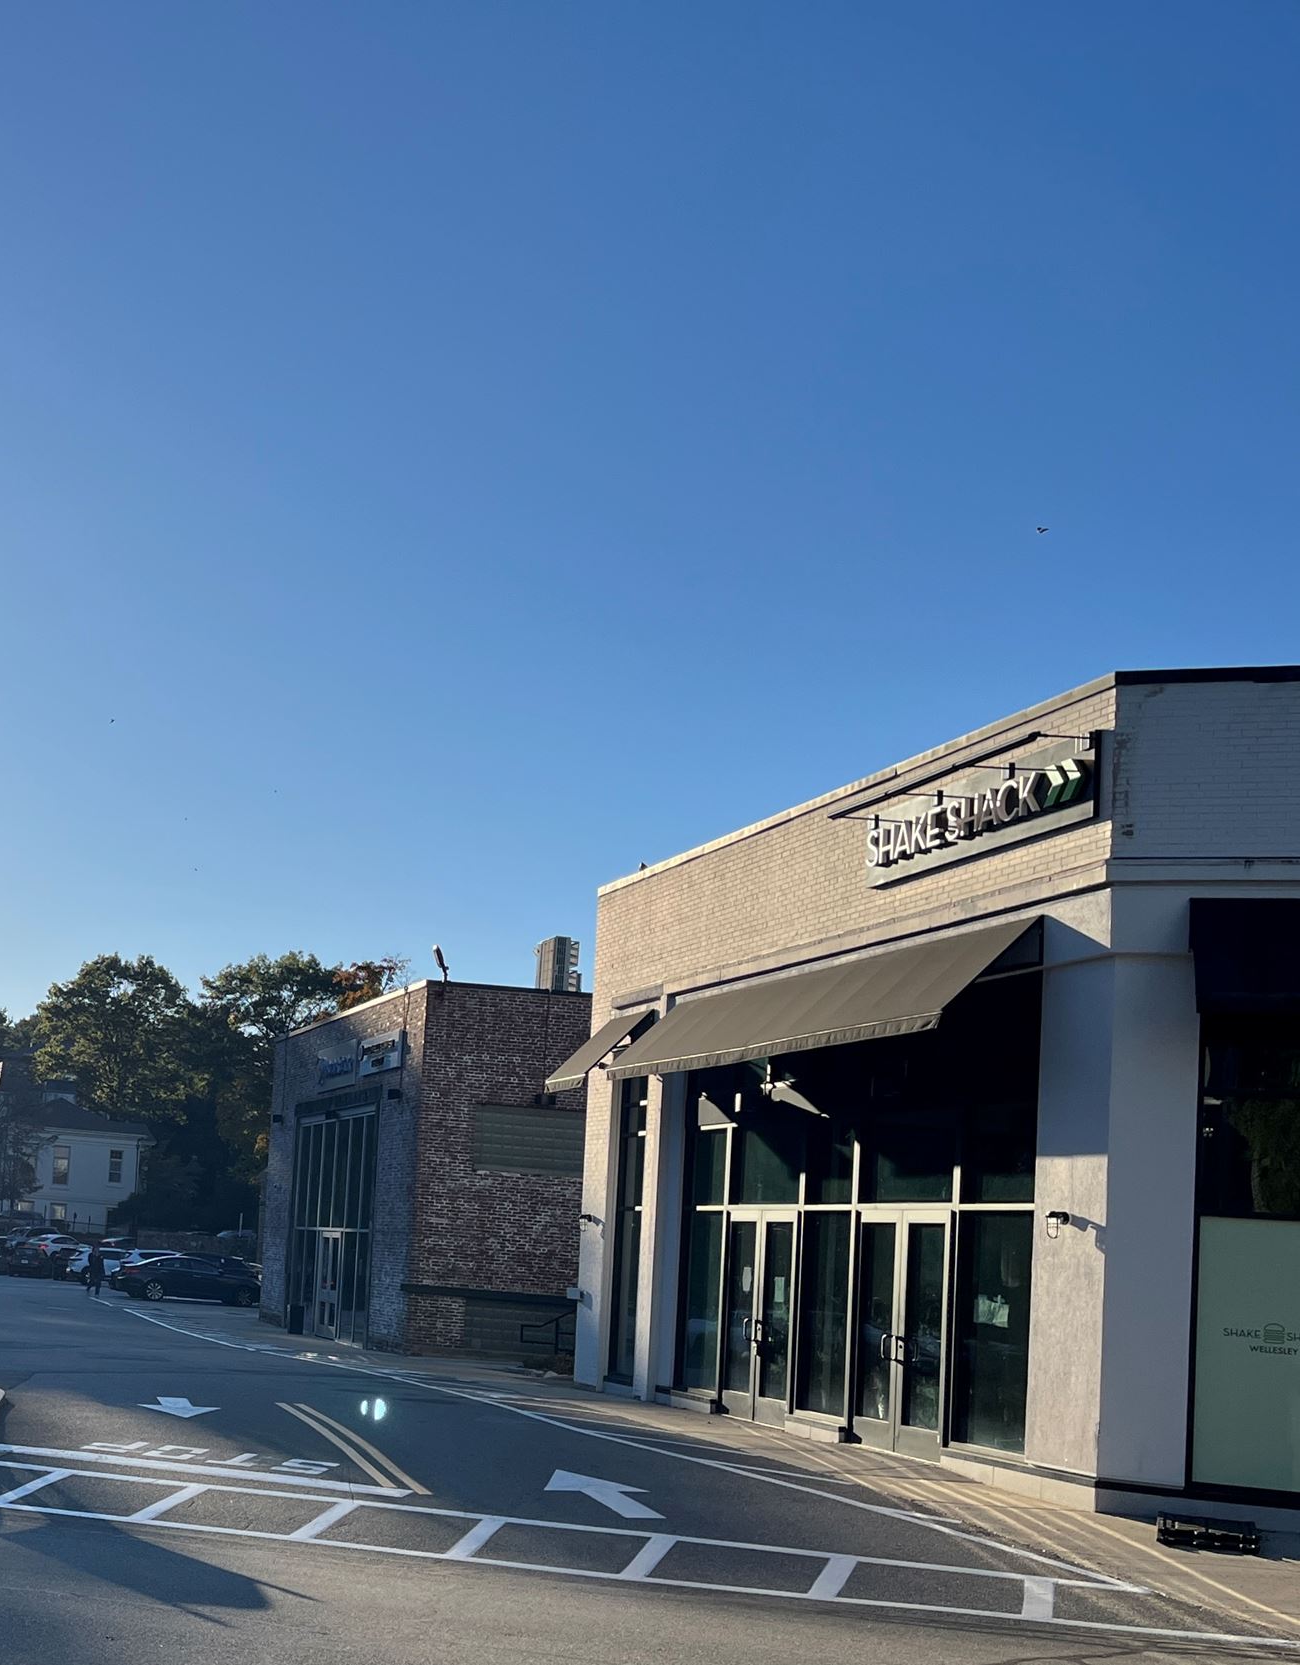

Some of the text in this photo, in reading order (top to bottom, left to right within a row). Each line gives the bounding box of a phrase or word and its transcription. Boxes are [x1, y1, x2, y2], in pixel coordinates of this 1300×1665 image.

[866, 770, 1041, 867] SHAKE SHACK
[1223, 1328, 1261, 1339] SHAKE
[1249, 1345, 1298, 1355] WELLESLEY
[80, 1440, 341, 1475] STOP
